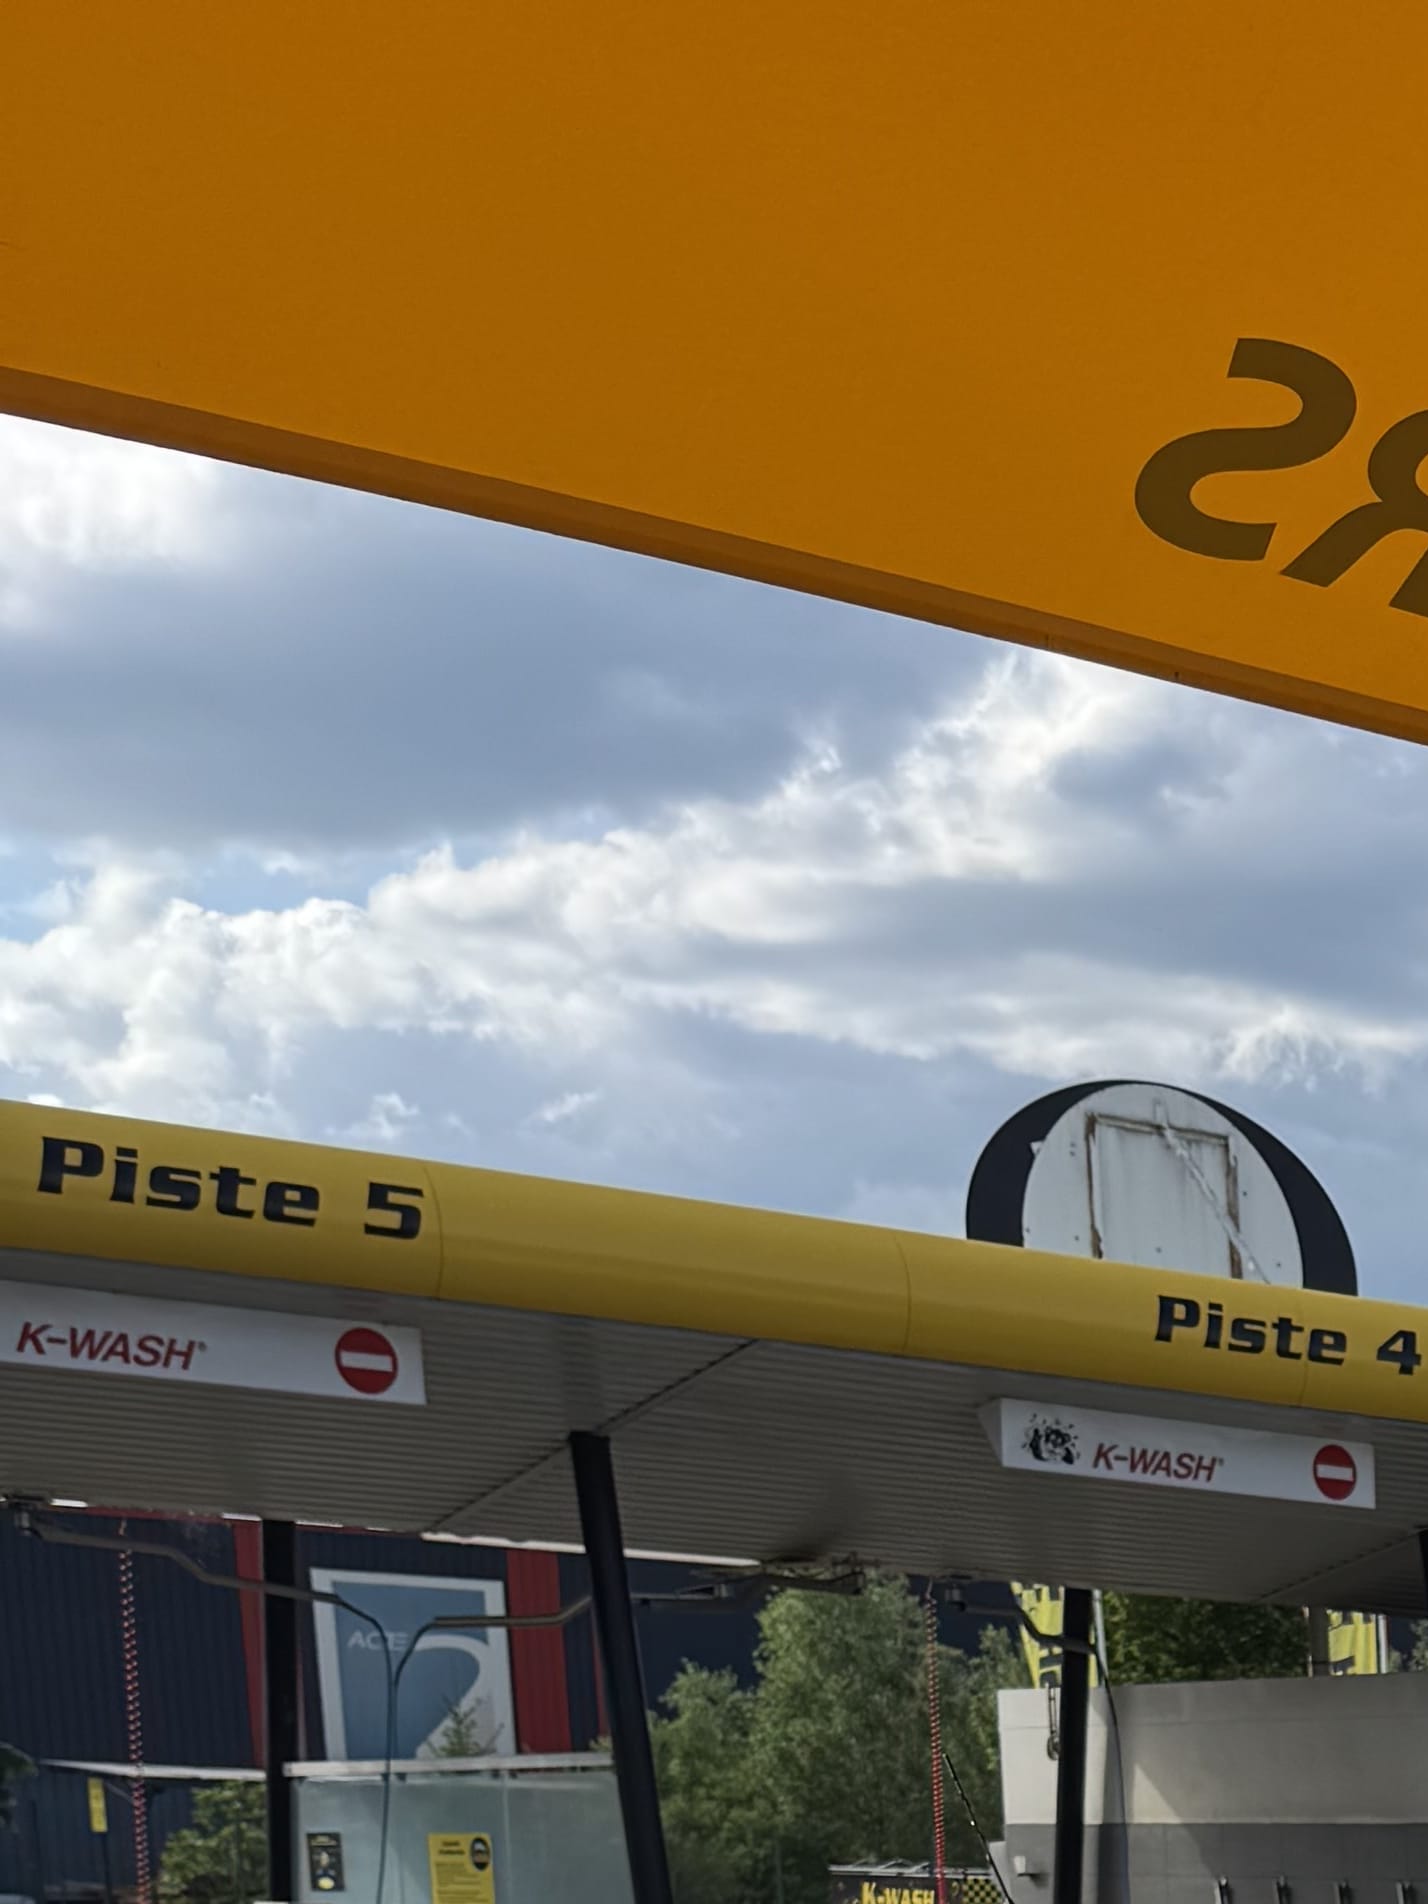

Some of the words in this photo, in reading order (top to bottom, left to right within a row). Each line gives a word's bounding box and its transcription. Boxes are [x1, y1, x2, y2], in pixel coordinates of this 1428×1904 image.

[37, 1136, 320, 1227] Piste
[363, 1181, 424, 1241] 5
[15, 1321, 197, 1371] K-WASH
[1154, 1295, 1347, 1365] Piste
[1376, 1329, 1423, 1376] 4
[1092, 1443, 1217, 1483] K-WASH
